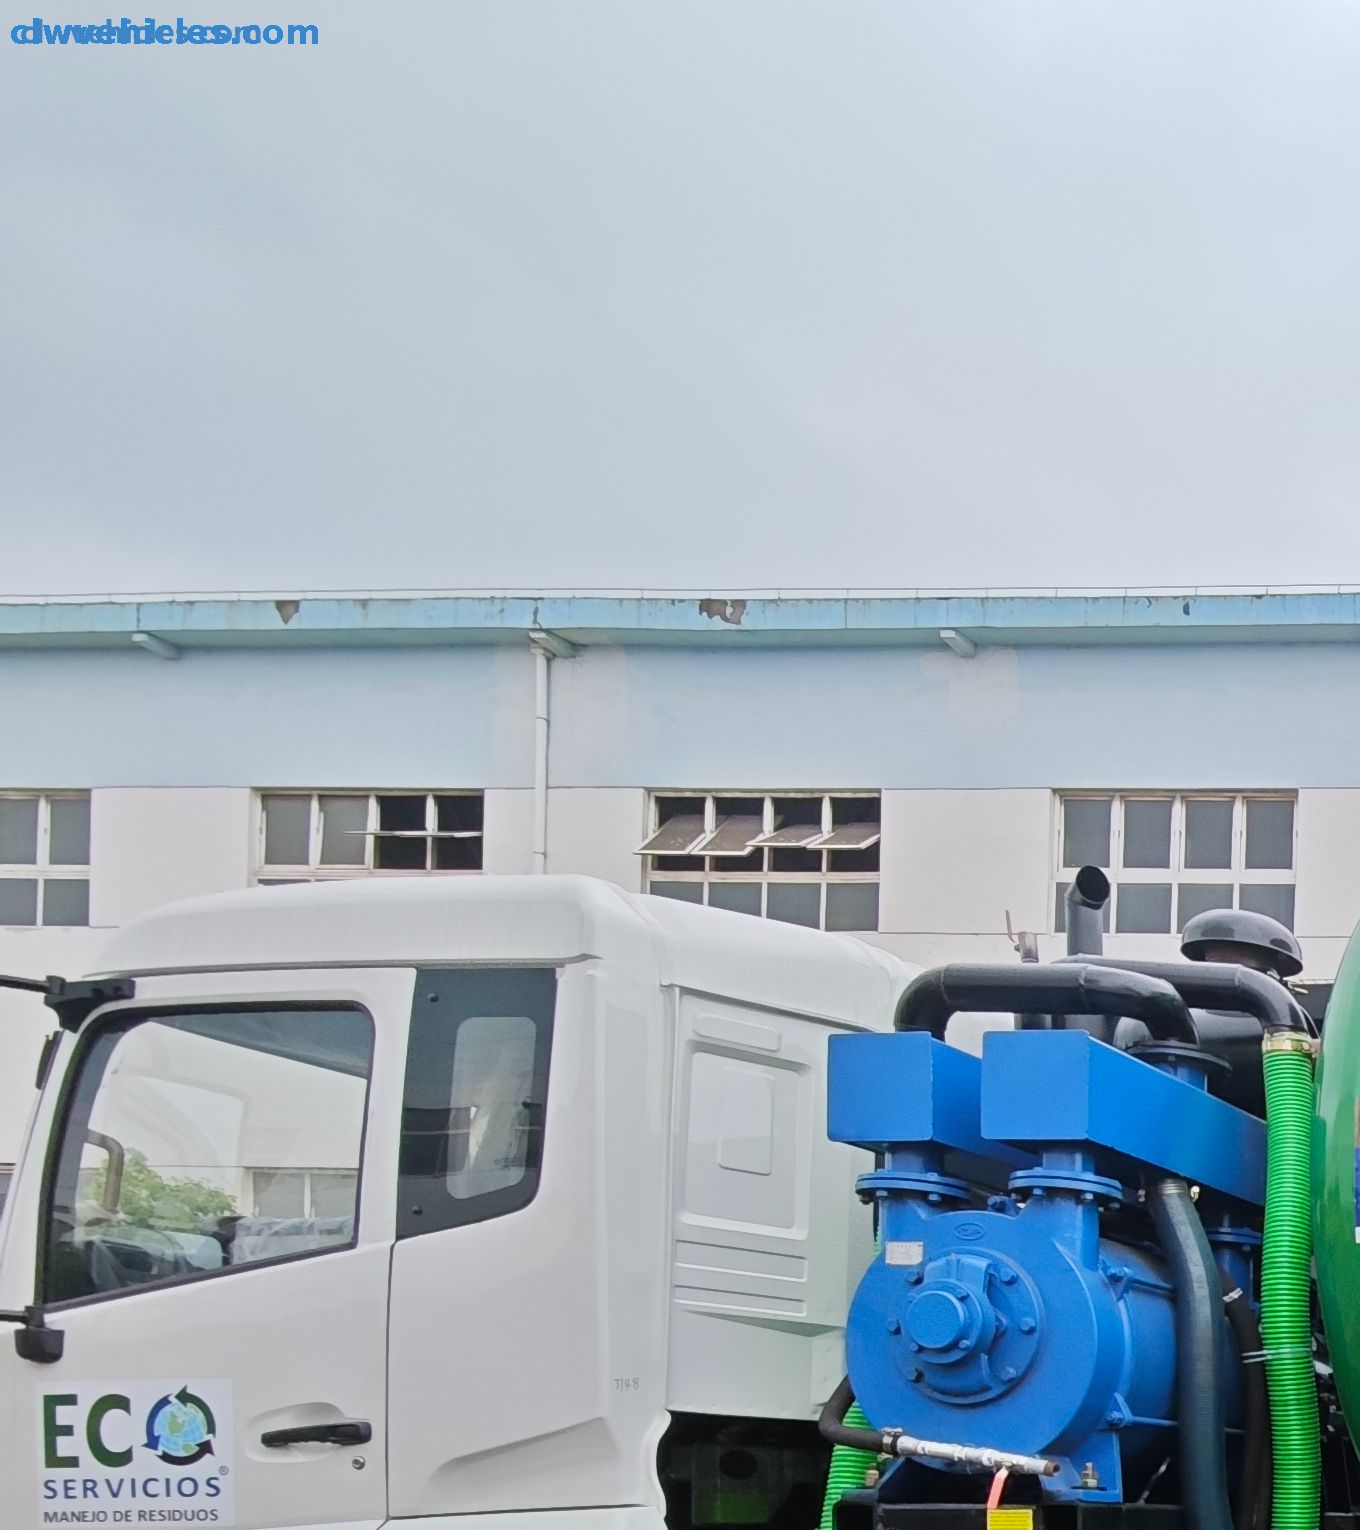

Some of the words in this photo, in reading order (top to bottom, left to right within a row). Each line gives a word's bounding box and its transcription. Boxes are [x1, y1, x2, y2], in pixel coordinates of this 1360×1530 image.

[43, 1476, 222, 1500] SERVICIOS
[43, 1509, 109, 1524] MANEJO
[112, 1509, 133, 1522] DE
[137, 1508, 219, 1522] RESIDUOS
